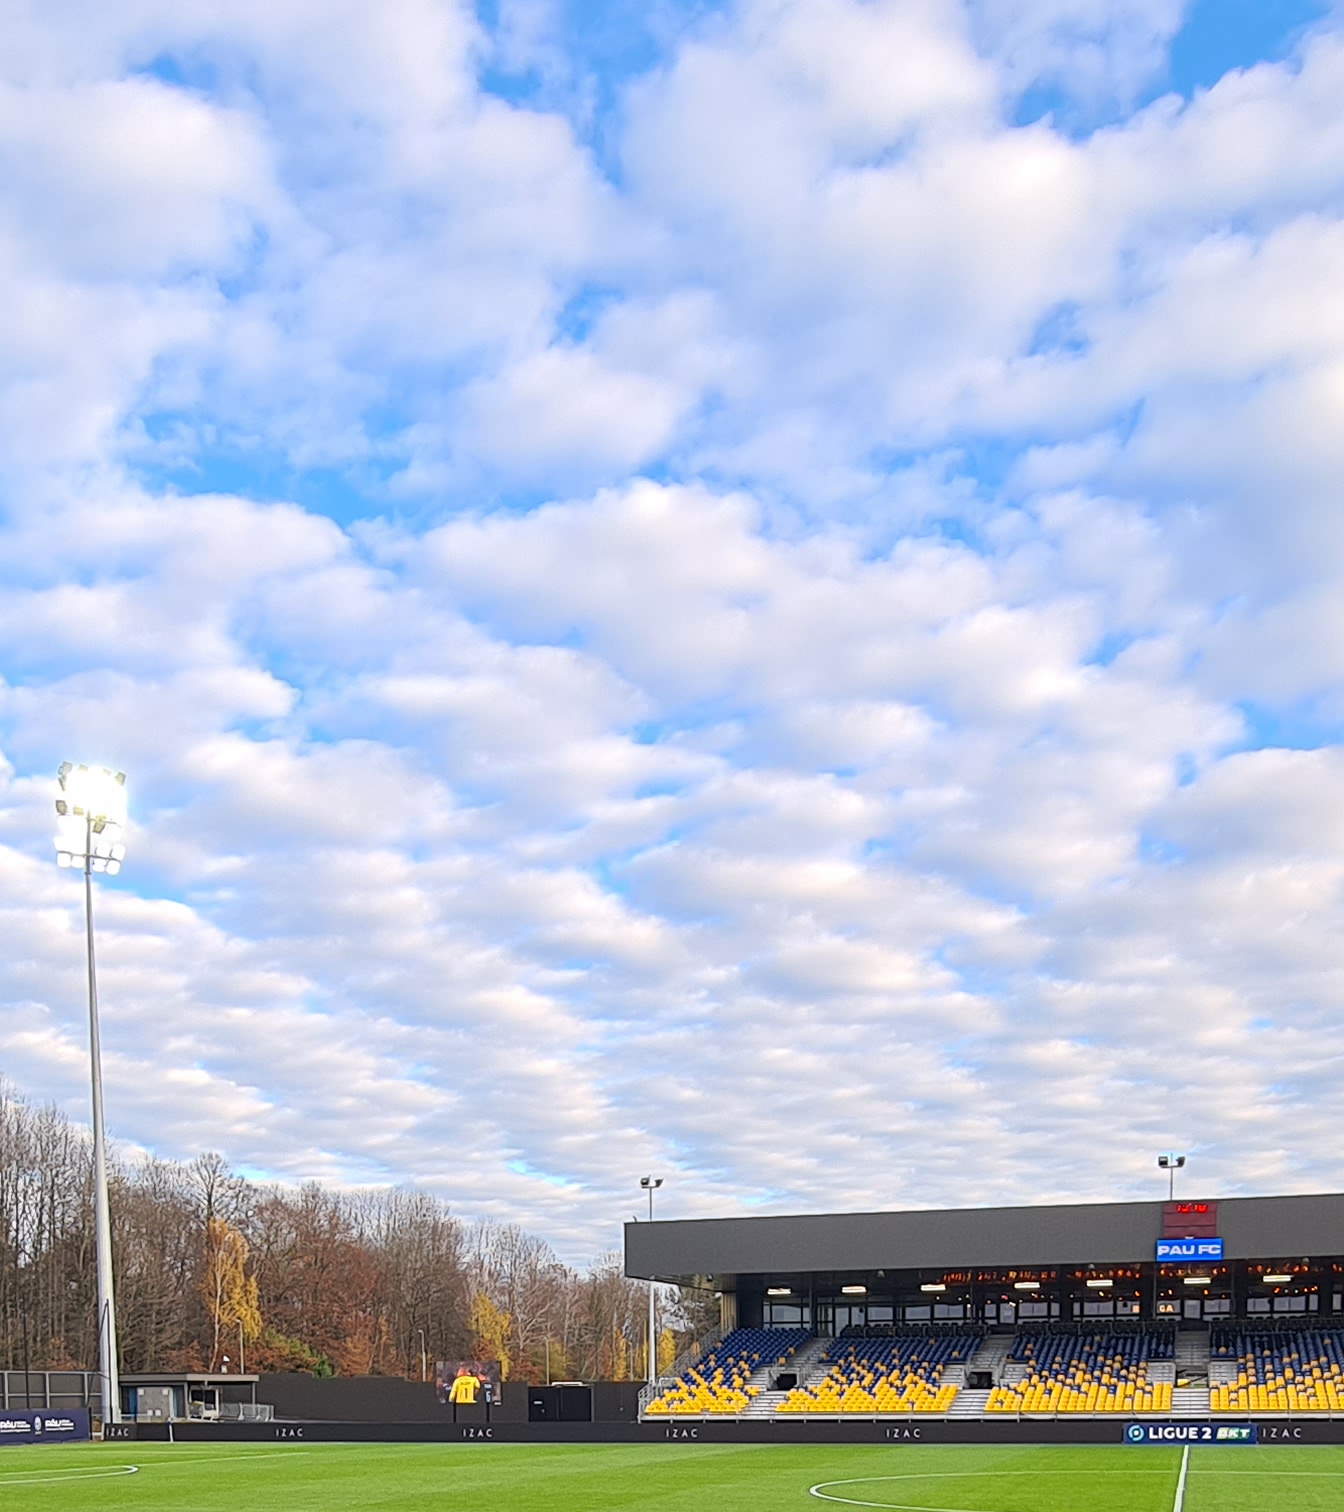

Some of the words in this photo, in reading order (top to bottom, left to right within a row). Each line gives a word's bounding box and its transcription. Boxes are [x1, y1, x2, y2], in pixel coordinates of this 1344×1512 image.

[1158, 1245, 1195, 1256] PAU
[1198, 1244, 1221, 1255] FC
[106, 1427, 129, 1437] IZAC
[276, 1428, 303, 1437] IZAC
[463, 1428, 493, 1437] IZAC
[666, 1428, 698, 1438] IZAC
[886, 1428, 921, 1438] IZAC
[1149, 1427, 1198, 1439] LIGUE
[1201, 1427, 1212, 1439] 2
[1216, 1428, 1250, 1440] BKT
[1262, 1427, 1302, 1438] IZAC
